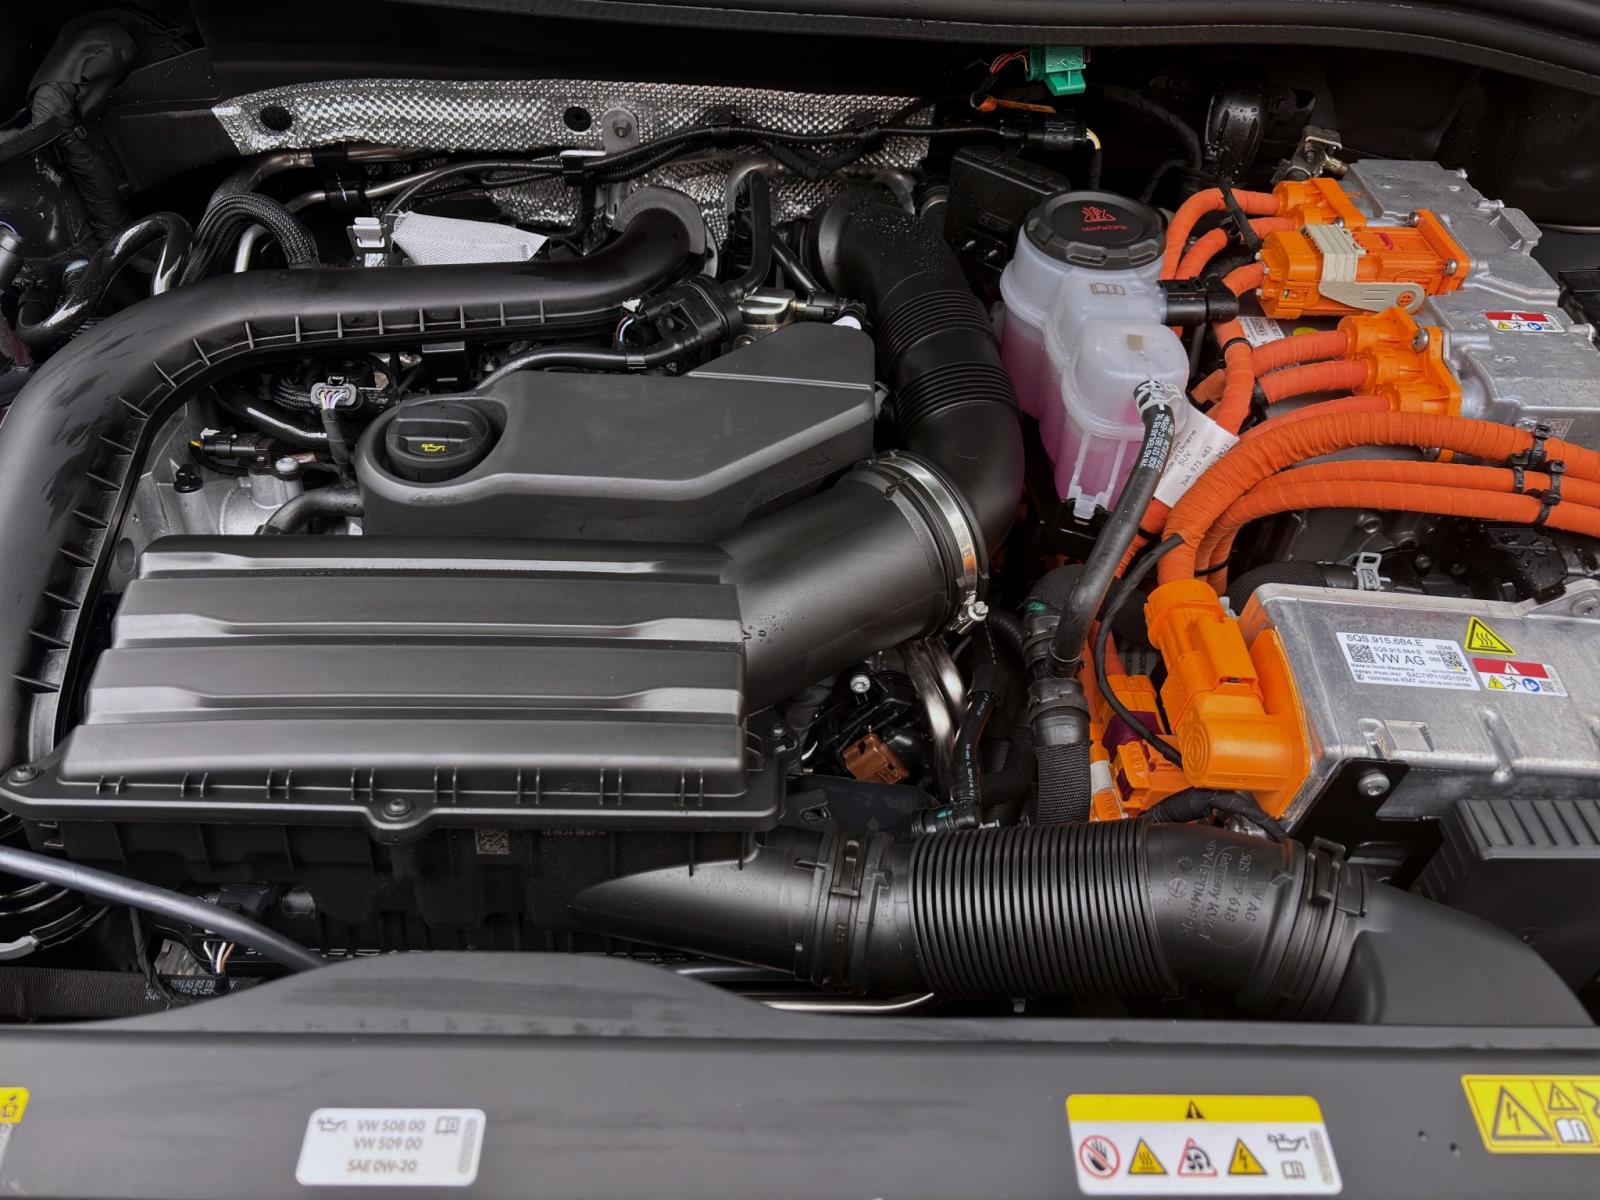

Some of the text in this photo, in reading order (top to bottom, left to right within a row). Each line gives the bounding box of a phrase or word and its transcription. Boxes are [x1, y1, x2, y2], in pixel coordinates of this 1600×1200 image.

[1178, 451, 1191, 466] SUV
[1376, 652, 1400, 663] VW
[1405, 655, 1426, 666] AG
[1244, 901, 1260, 922] AG
[357, 1119, 379, 1132] VW
[408, 1119, 427, 1133] 00
[354, 1137, 376, 1150] VW
[404, 1137, 423, 1150] 00
[346, 1159, 371, 1173] SAE
